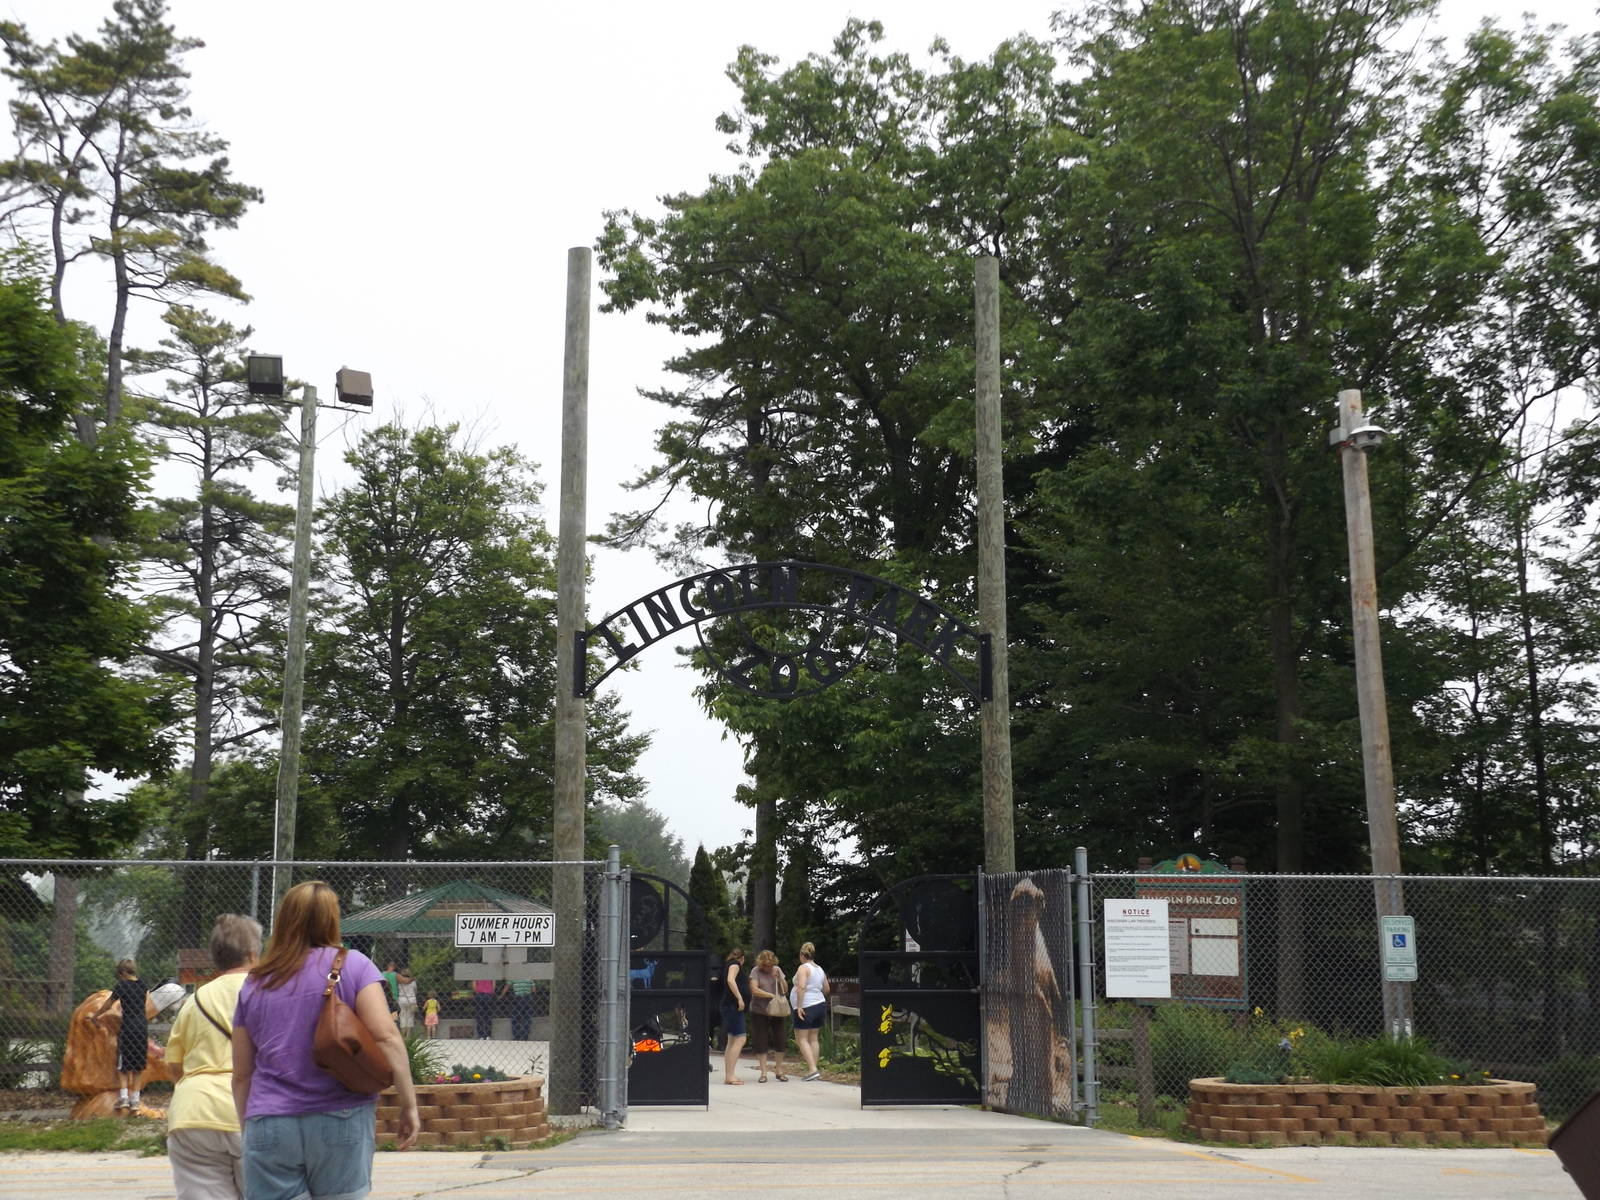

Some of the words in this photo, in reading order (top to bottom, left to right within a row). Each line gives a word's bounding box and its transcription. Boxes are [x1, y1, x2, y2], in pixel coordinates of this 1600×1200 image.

[600, 565, 797, 660] LINCOLN
[848, 573, 964, 658] PARK
[729, 646, 840, 692] ZOO
[1185, 895, 1212, 904] PARK
[1214, 895, 1237, 904] ZOO
[461, 917, 509, 929] SUMMER
[512, 917, 550, 929] HOURS
[470, 931, 475, 943] 7
[479, 931, 497, 943] AM
[514, 931, 520, 943] 7
[524, 931, 541, 943] PM
